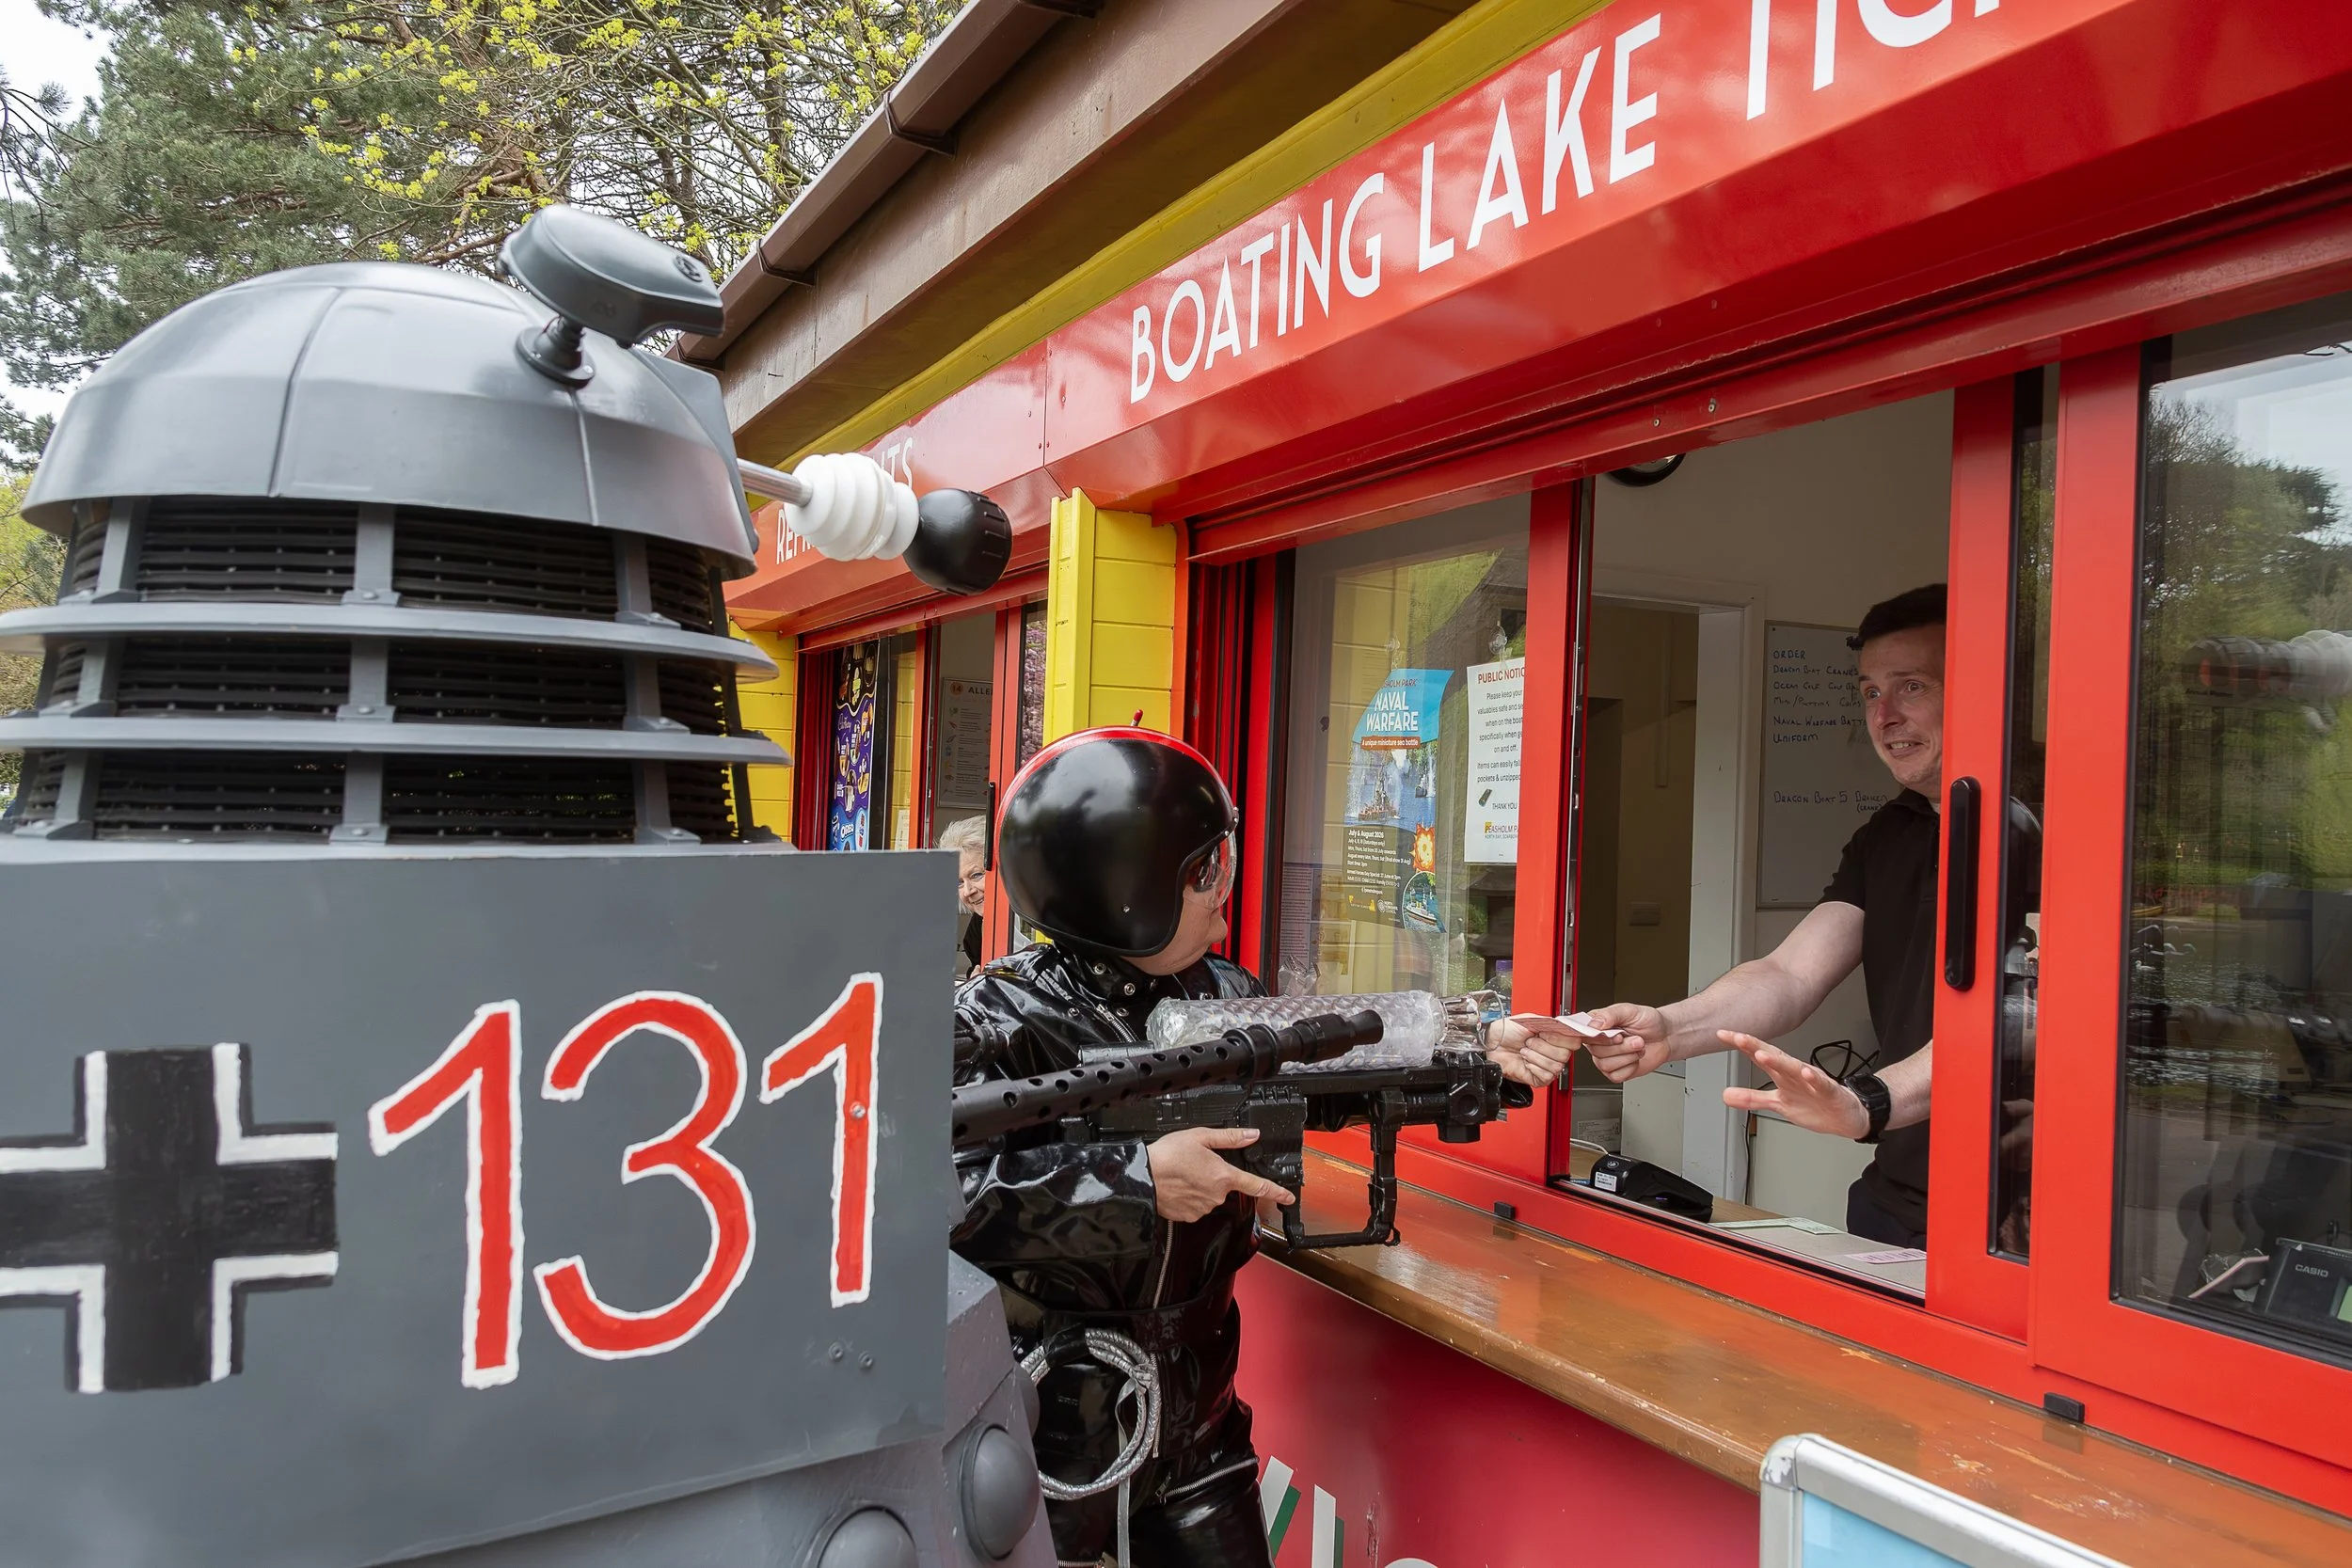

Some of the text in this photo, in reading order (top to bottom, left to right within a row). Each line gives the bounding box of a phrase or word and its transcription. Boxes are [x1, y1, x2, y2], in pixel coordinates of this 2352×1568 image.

[1130, 170, 1384, 405] BOATING
[1419, 12, 1662, 273] LAKE
[1772, 650, 1805, 659] ORDER
[1478, 667, 1525, 684] PUBLIC NOTIC
[952, 685, 961, 693] 14
[1486, 689, 1522, 701] Please keep your
[1374, 691, 1409, 712] NAVAL
[1477, 706, 1498, 715] valuables
[1498, 705, 1508, 713] safe
[1366, 711, 1419, 732] WARFARE
[1504, 717, 1513, 725] the
[1773, 716, 1801, 725] NAVAL
[1805, 716, 1837, 726] WARFARE
[1479, 732, 1504, 742] specifically
[1365, 738, 1376, 748] unique
[1501, 744, 1510, 752] and
[1510, 744, 1518, 752] off.
[1500, 759, 1513, 769] easily
[1477, 775, 1495, 784] pockets
[1496, 773, 1500, 782] &
[1773, 791, 1808, 803] DRAGON
[1814, 791, 1836, 803] BOAT
[1838, 790, 1848, 803] 5
[840, 823, 854, 839] OREO
[1485, 824, 1513, 834] PEASHOLM
[1348, 830, 1357, 838] July
[1360, 830, 1374, 839] August
[368, 972, 883, 1390] 131
[2295, 1263, 2328, 1278] CASIO
